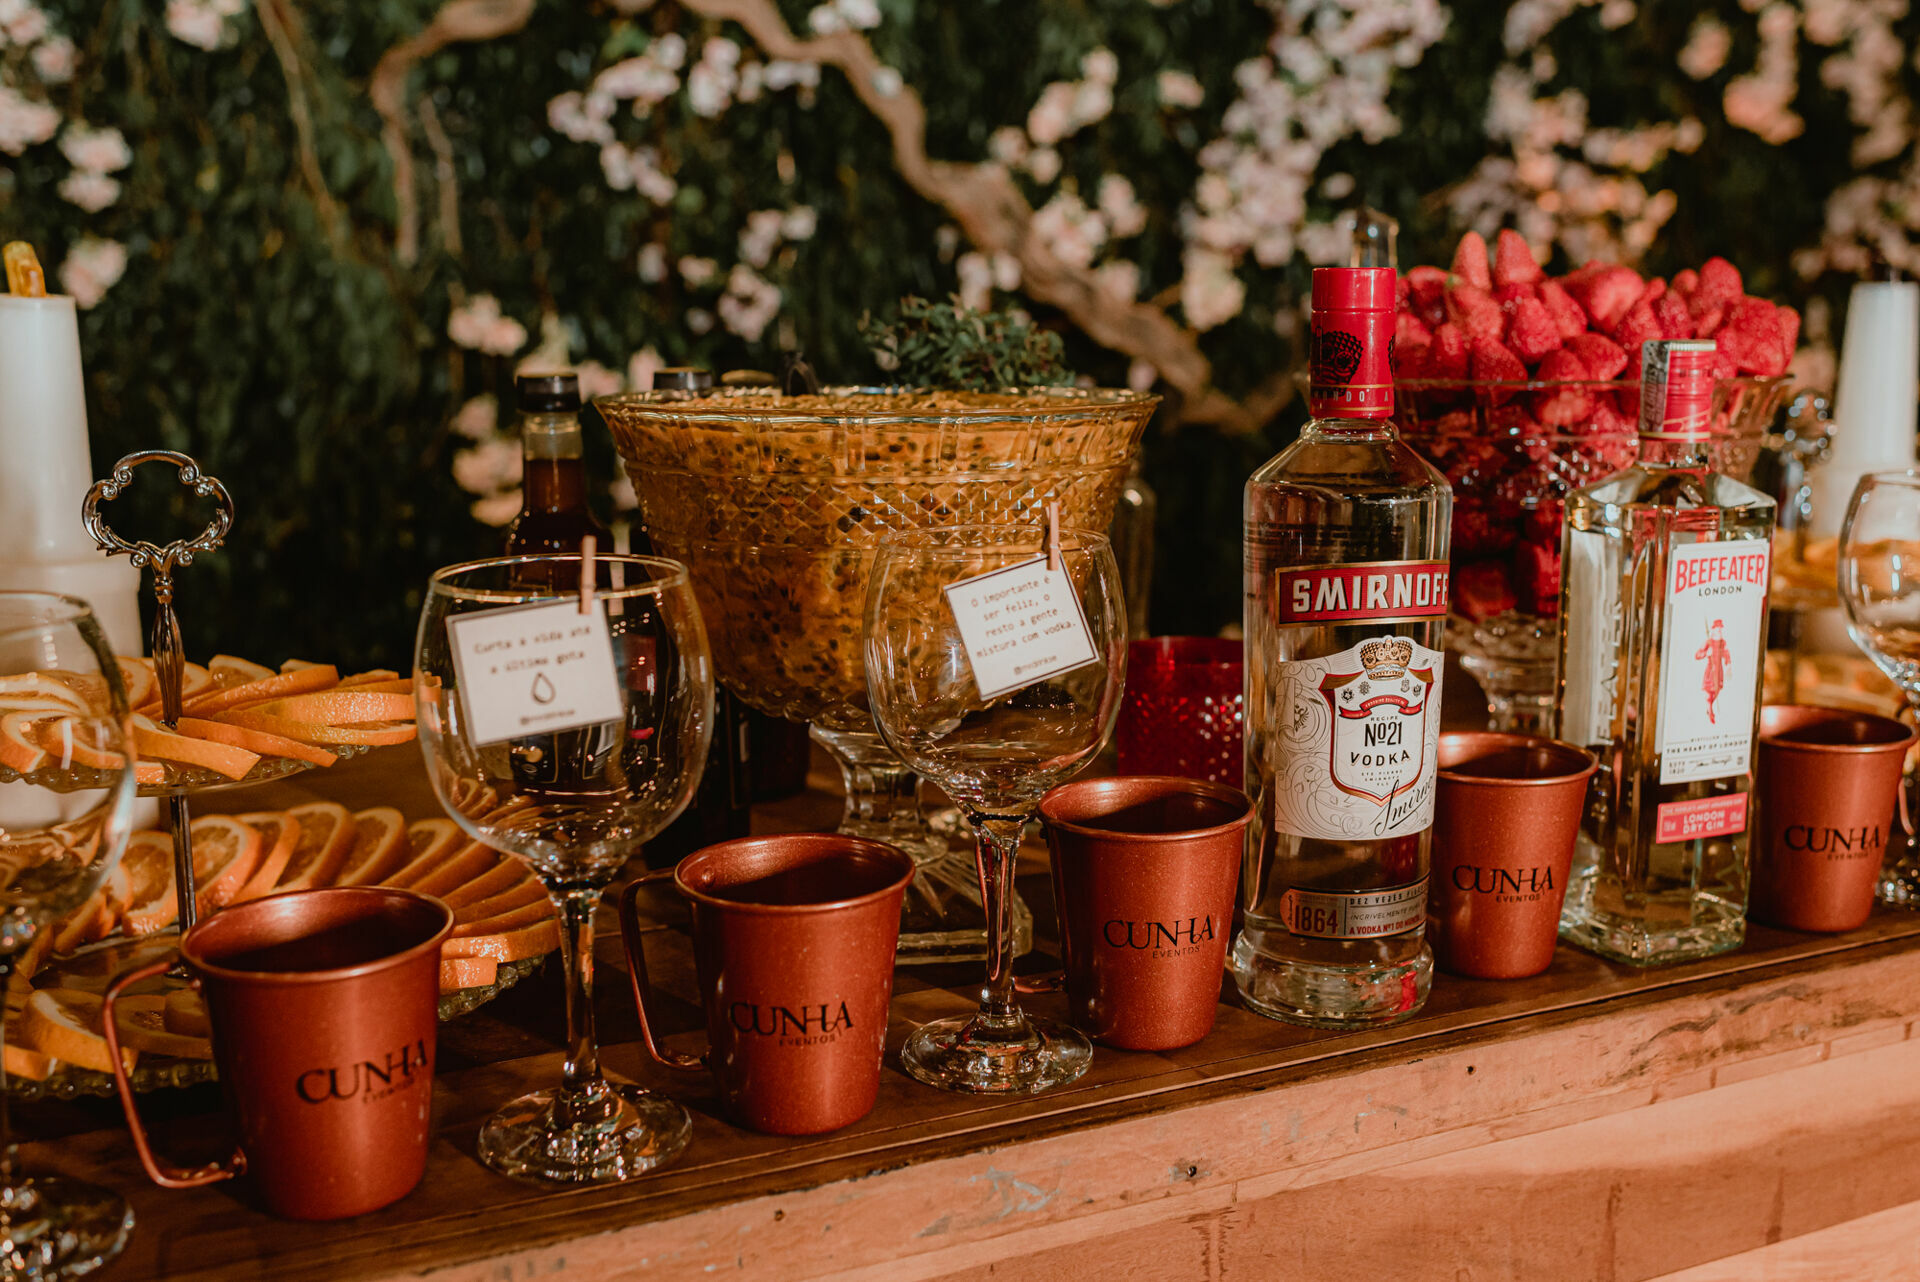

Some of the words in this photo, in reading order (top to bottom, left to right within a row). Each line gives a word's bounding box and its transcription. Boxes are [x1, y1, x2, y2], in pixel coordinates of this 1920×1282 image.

[1674, 553, 1766, 595] BEEFEATER
[970, 598, 979, 608] O
[984, 580, 1039, 603] importante
[1292, 572, 1449, 613] SMIRNOFF
[1698, 585, 1742, 597] LONDON
[983, 610, 1000, 622] ser
[1005, 598, 1039, 613] feliz,
[1043, 593, 1050, 602] o
[985, 622, 1015, 638] resto
[1019, 619, 1026, 627] a
[1030, 607, 1059, 626] gente
[976, 639, 1017, 658] mistura
[1022, 631, 1039, 644] com
[1044, 620, 1076, 635] vodka.
[1349, 749, 1411, 768] VODKA
[1682, 822, 1703, 835] DRY
[1705, 819, 1725, 831] GIN
[1683, 810, 1726, 825] LONDON
[1452, 865, 1554, 894] CUNHA
[1349, 896, 1369, 906] DEZ
[1374, 893, 1404, 905] VEZES
[1495, 893, 1541, 903] EVENTOS
[1103, 914, 1214, 949] CUNHA
[1294, 904, 1339, 935] 1864
[1349, 926, 1356, 935] A
[1356, 924, 1383, 935] VODKA
[1152, 943, 1200, 960] EVENTOS
[730, 1000, 854, 1037] CUNHA
[779, 1033, 836, 1047] EVENTOS
